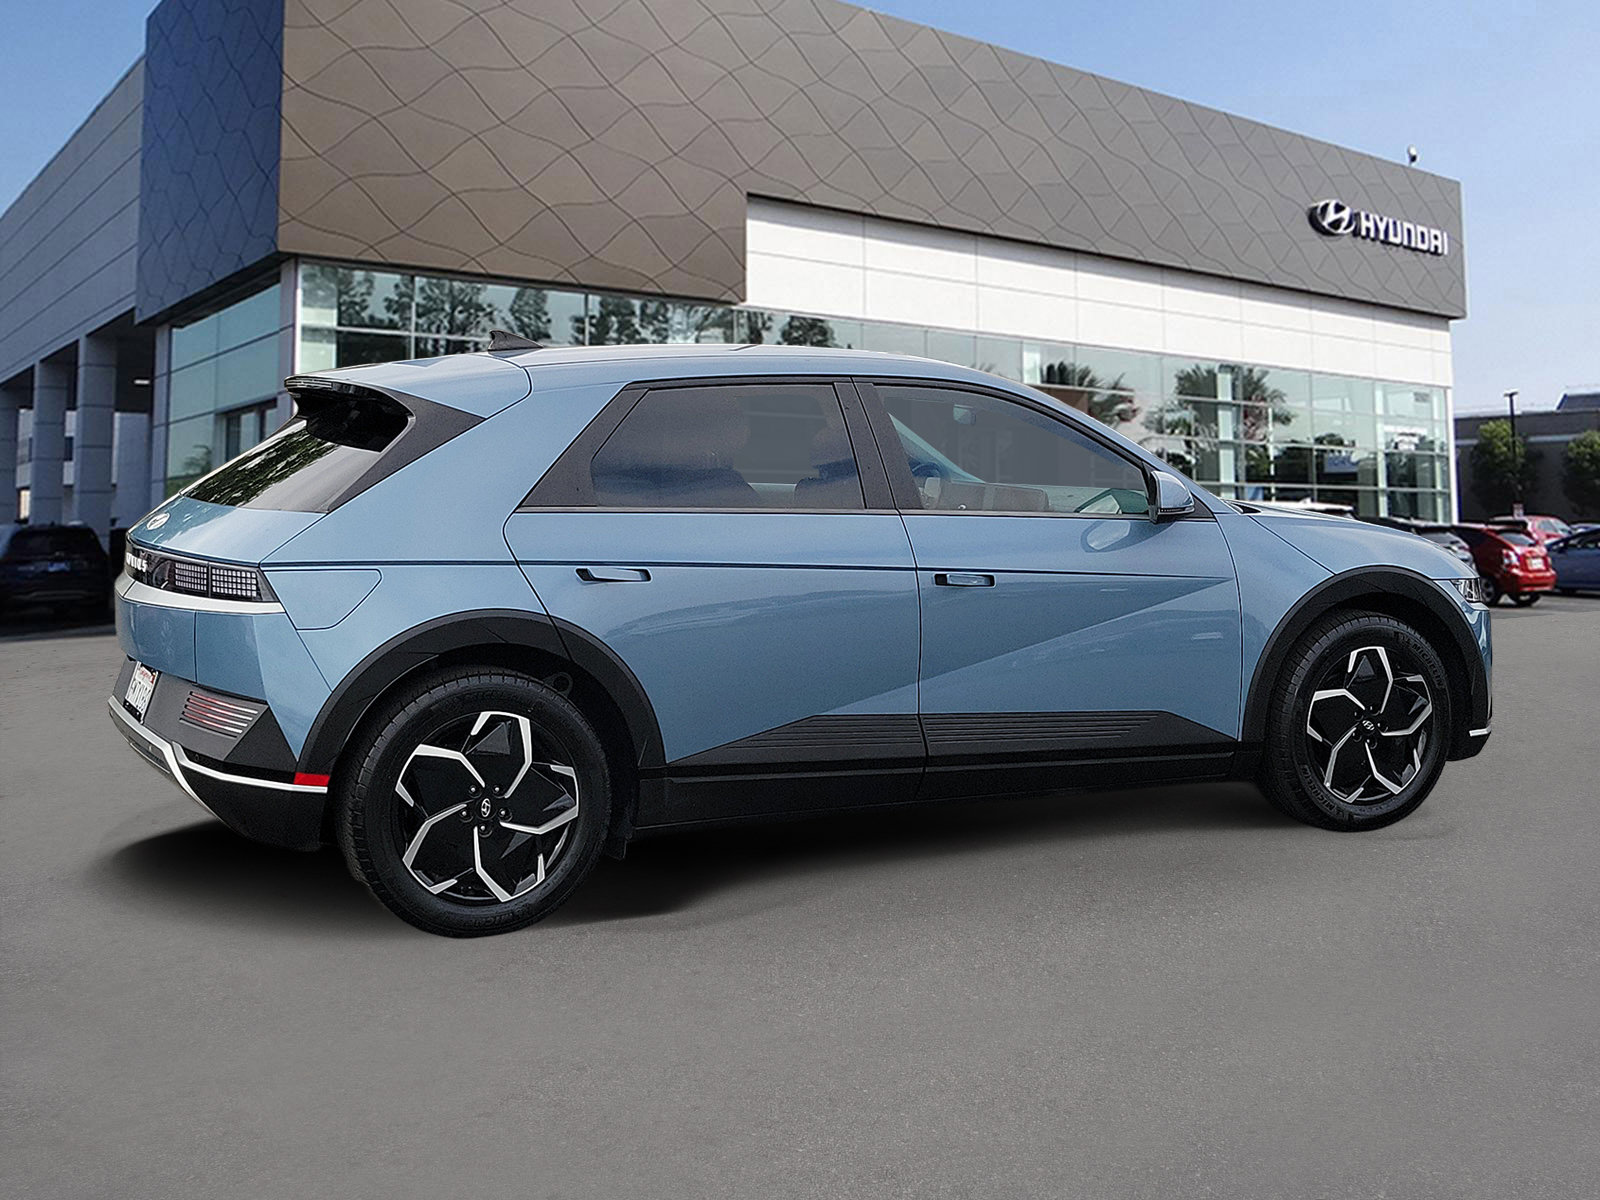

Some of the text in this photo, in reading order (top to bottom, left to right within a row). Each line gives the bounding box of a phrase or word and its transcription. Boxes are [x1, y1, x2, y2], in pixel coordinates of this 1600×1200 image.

[1360, 211, 1448, 255] HYUNDAI
[1409, 642, 1443, 686] MICHELIN
[1301, 767, 1336, 811] MICHELIN
